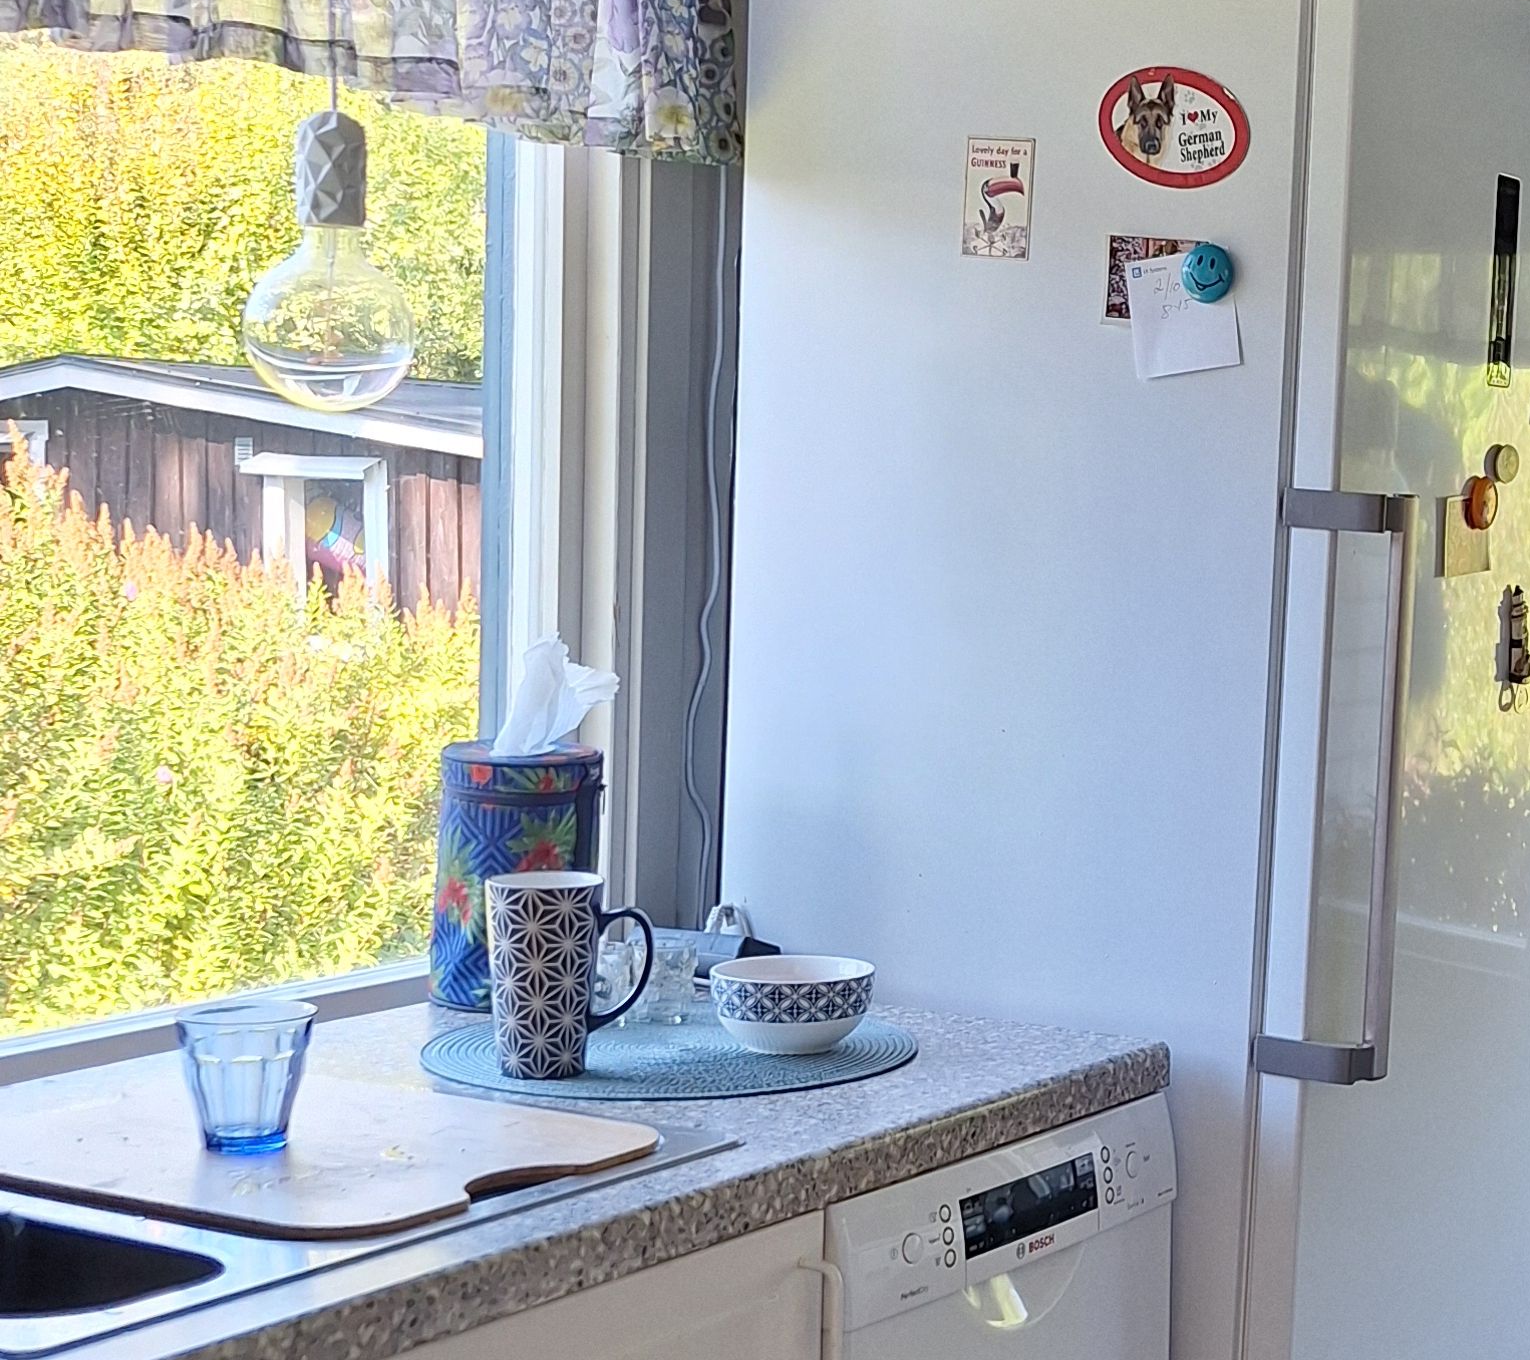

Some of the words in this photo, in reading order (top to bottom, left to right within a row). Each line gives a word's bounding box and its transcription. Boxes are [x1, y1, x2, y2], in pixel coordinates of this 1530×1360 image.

[1200, 109, 1218, 124] My
[1178, 130, 1222, 147] German
[996, 146, 1009, 156] day
[1180, 140, 1226, 163] Shepherd
[971, 157, 1007, 168] GUINNESS
[1029, 1233, 1055, 1253] BOSCH
